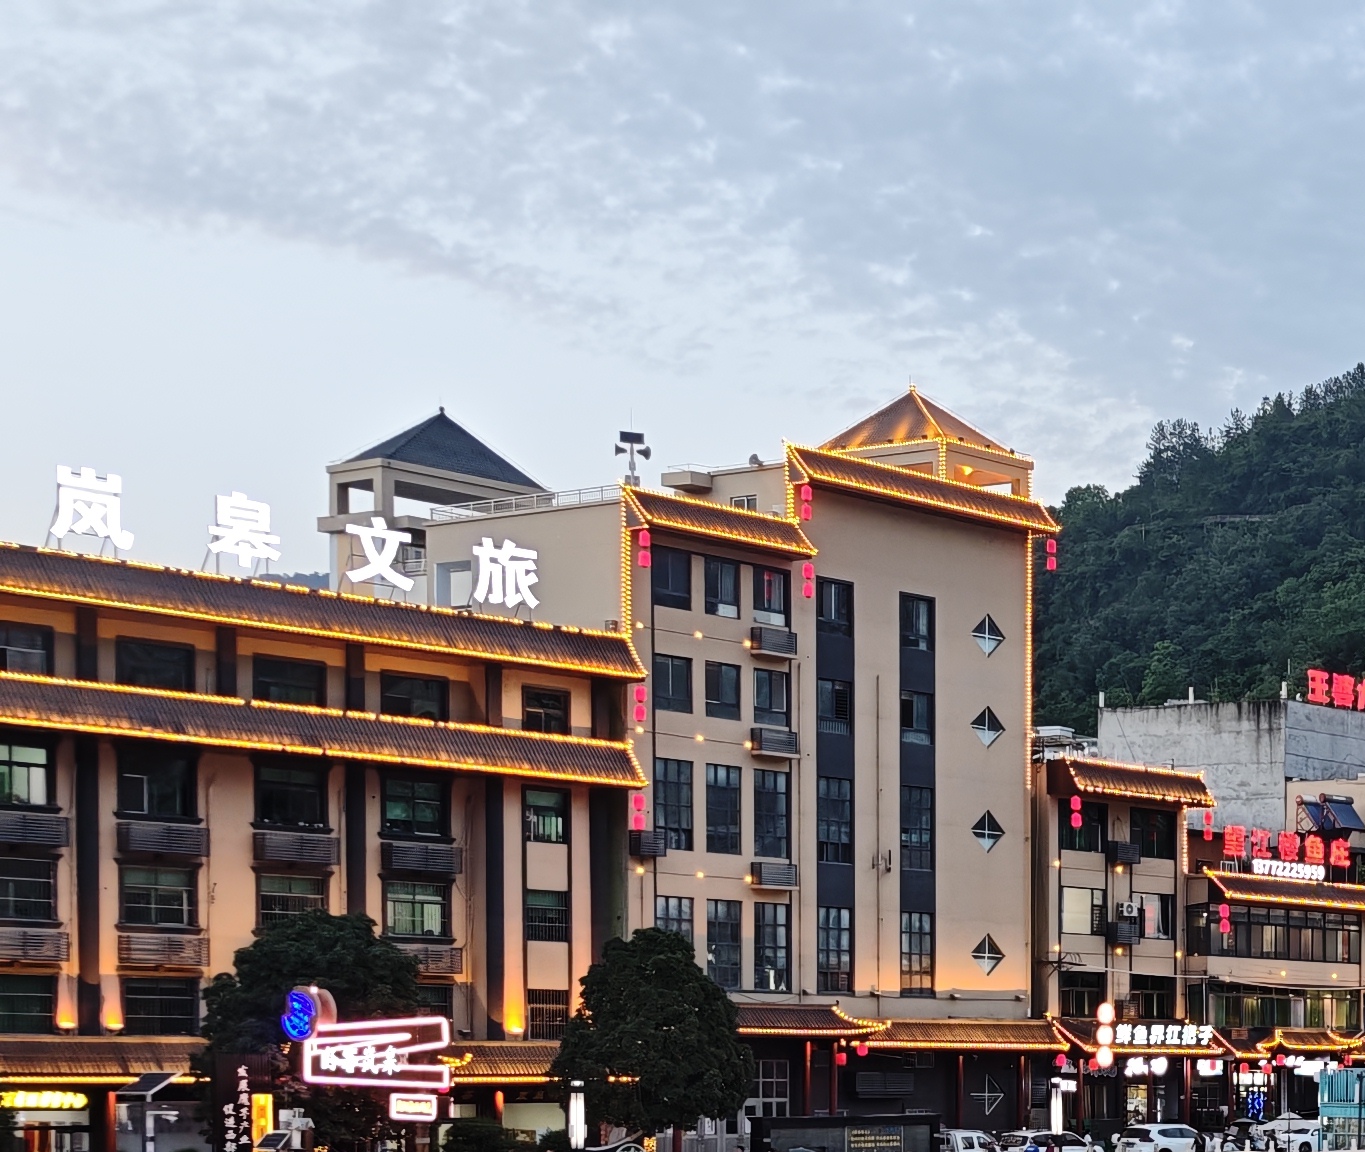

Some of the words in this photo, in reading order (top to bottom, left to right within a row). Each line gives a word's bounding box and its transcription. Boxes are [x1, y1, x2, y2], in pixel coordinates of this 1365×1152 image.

[50, 464, 540, 609] 岚皋文旅
[1223, 824, 1351, 867] 望江楼鱼庄
[1251, 858, 1325, 881] 13772225959
